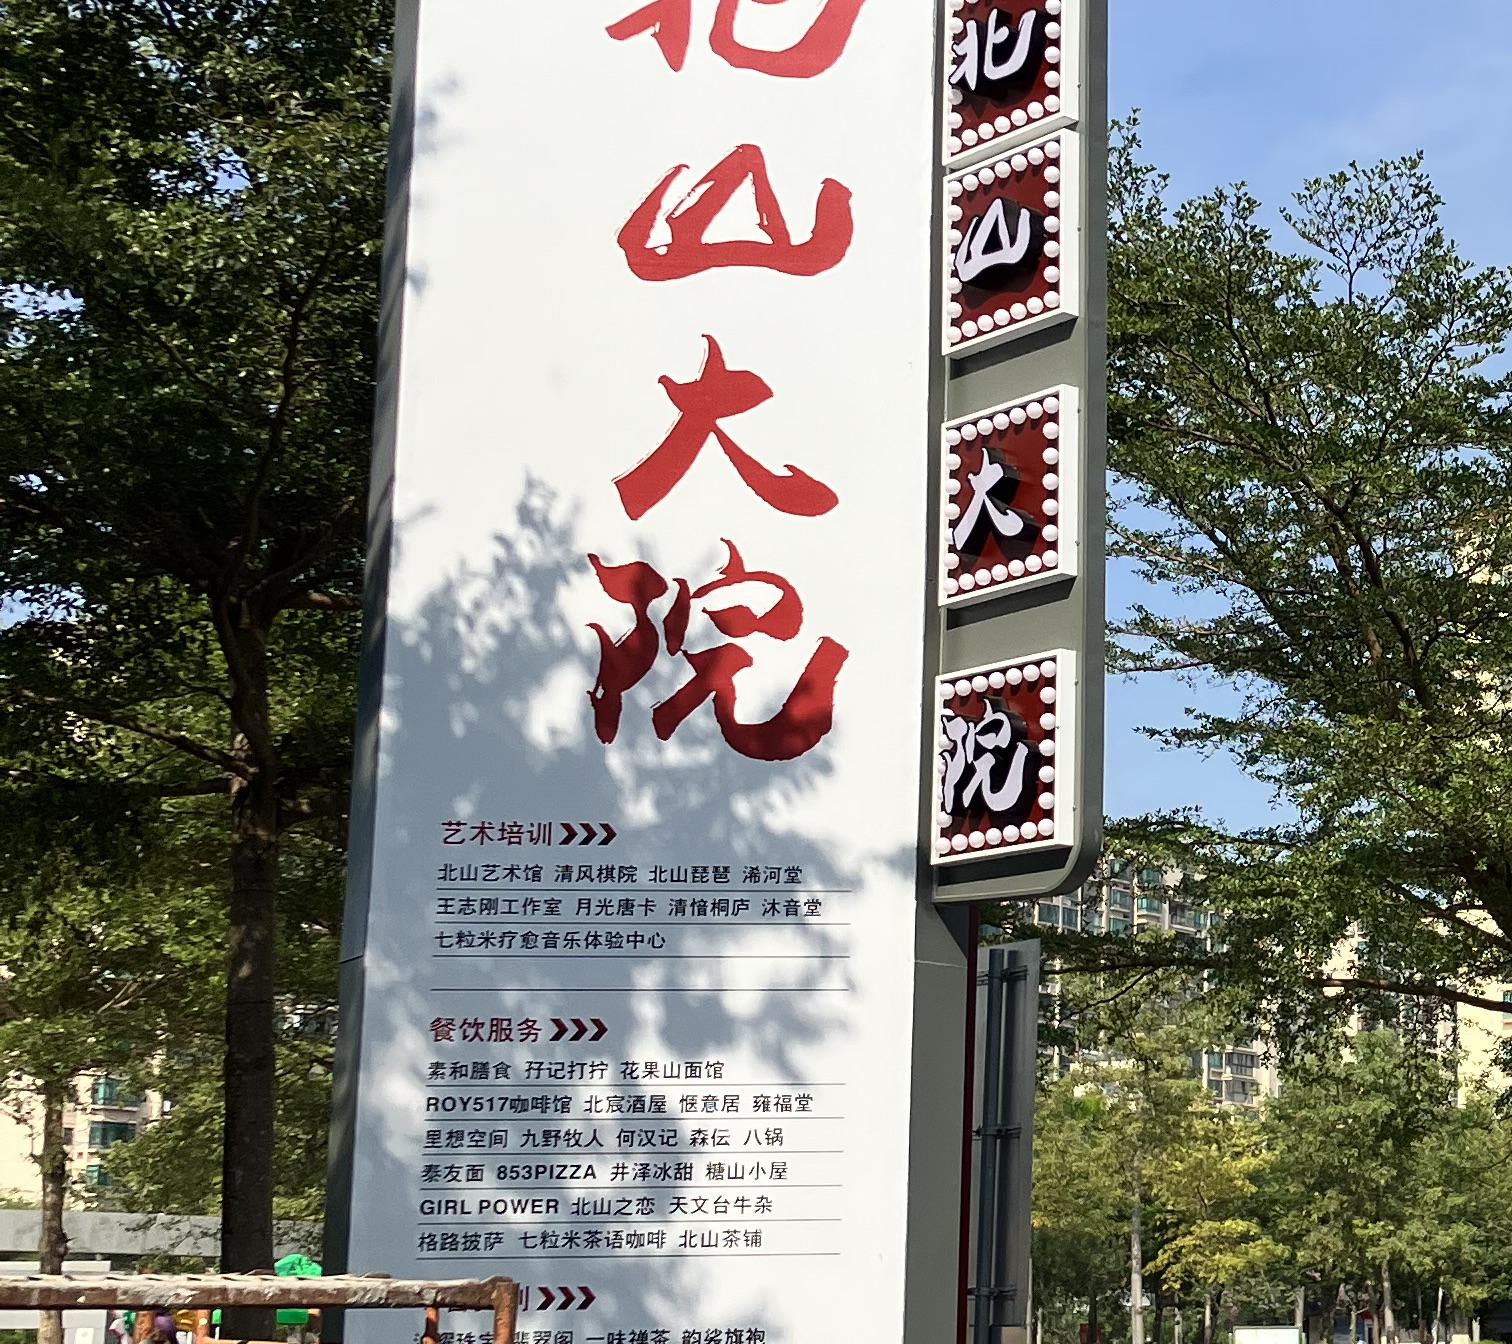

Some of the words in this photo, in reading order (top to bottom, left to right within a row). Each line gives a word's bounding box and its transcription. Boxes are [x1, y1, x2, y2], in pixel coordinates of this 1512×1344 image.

[940, 8, 1036, 814] 北山大院
[441, 820, 552, 846] 艺术培训
[437, 863, 543, 882] 北山艺术馆
[555, 864, 637, 883] 清风棋院
[649, 865, 730, 883] 北山琵琶
[436, 897, 562, 916] 王志刚工作室
[576, 898, 656, 916] 月光唐卡
[762, 898, 821, 917] 沐音堂
[434, 930, 666, 949] 七粒米疗愈音乐体验中心
[430, 1017, 542, 1042] 餐饮服务
[427, 1061, 512, 1080] 素和膳食
[619, 1061, 724, 1080] 花果山面馆
[426, 1095, 572, 1114] ROY517咖啡馆
[584, 1095, 667, 1113] 北宸酒屋
[753, 1093, 813, 1112] 雍福堂
[423, 1129, 508, 1148] 里想空间
[520, 1128, 604, 1148] 九野牧人
[616, 1128, 678, 1147] 何汉记
[743, 1128, 783, 1146] 八锅
[497, 1165, 596, 1180] 853PIZZA
[611, 1162, 693, 1181] 井泽冰甜
[706, 1161, 788, 1180] 糖山小屋
[420, 1200, 471, 1215] GIRL
[479, 1199, 559, 1215] POWER
[570, 1197, 655, 1216] 北山之恋
[668, 1195, 772, 1214] 天文台牛杂
[417, 1232, 504, 1252] 格路披萨
[518, 1230, 666, 1249] 七粒米茶语咖啡
[679, 1229, 762, 1248] 北山茶铺
